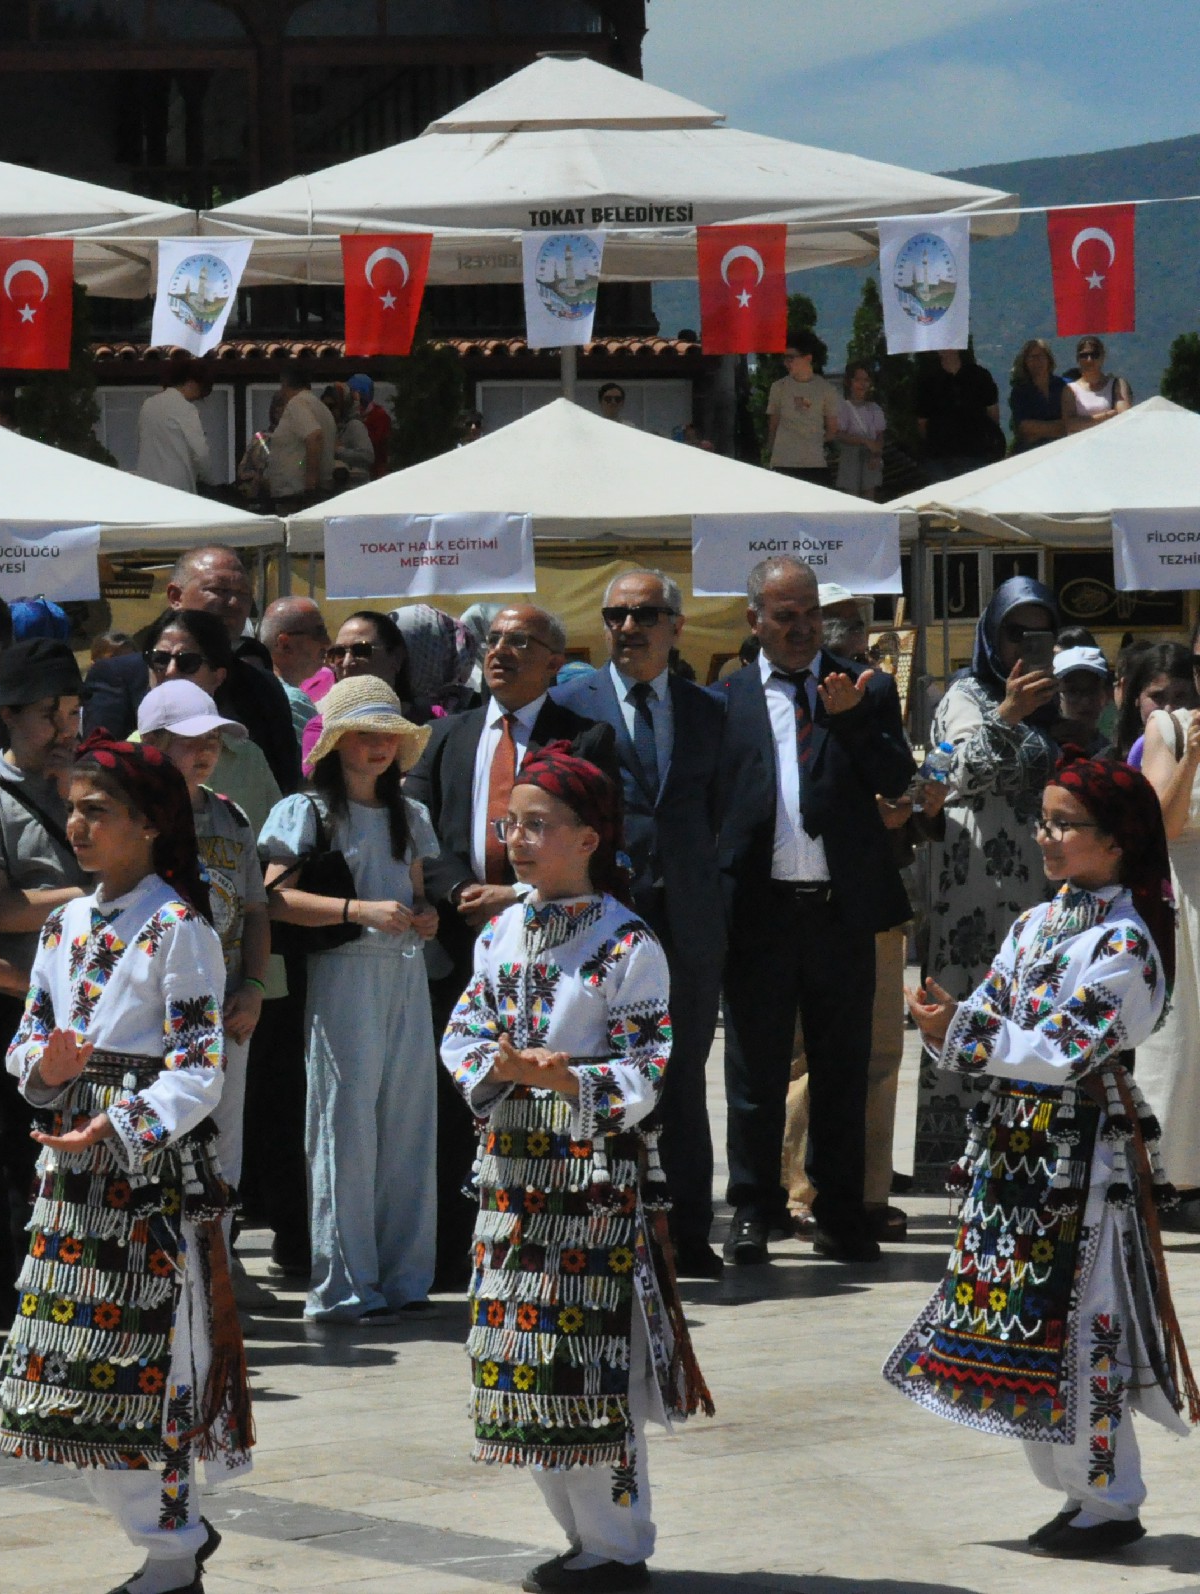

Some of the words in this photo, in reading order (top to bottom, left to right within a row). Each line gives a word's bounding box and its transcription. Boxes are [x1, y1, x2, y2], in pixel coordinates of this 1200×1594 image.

[528, 208, 586, 227] TOKAT
[591, 202, 694, 224] BELEDİYESİ
[360, 542, 405, 554] TOKAT
[408, 540, 444, 551] HALK
[448, 536, 498, 551] EĞİTİMİ
[749, 538, 788, 551] KAĞIT
[793, 537, 844, 551] RÖLYEF
[399, 553, 459, 568] MERKEZİ
[1158, 552, 1200, 565] TEZHİ
